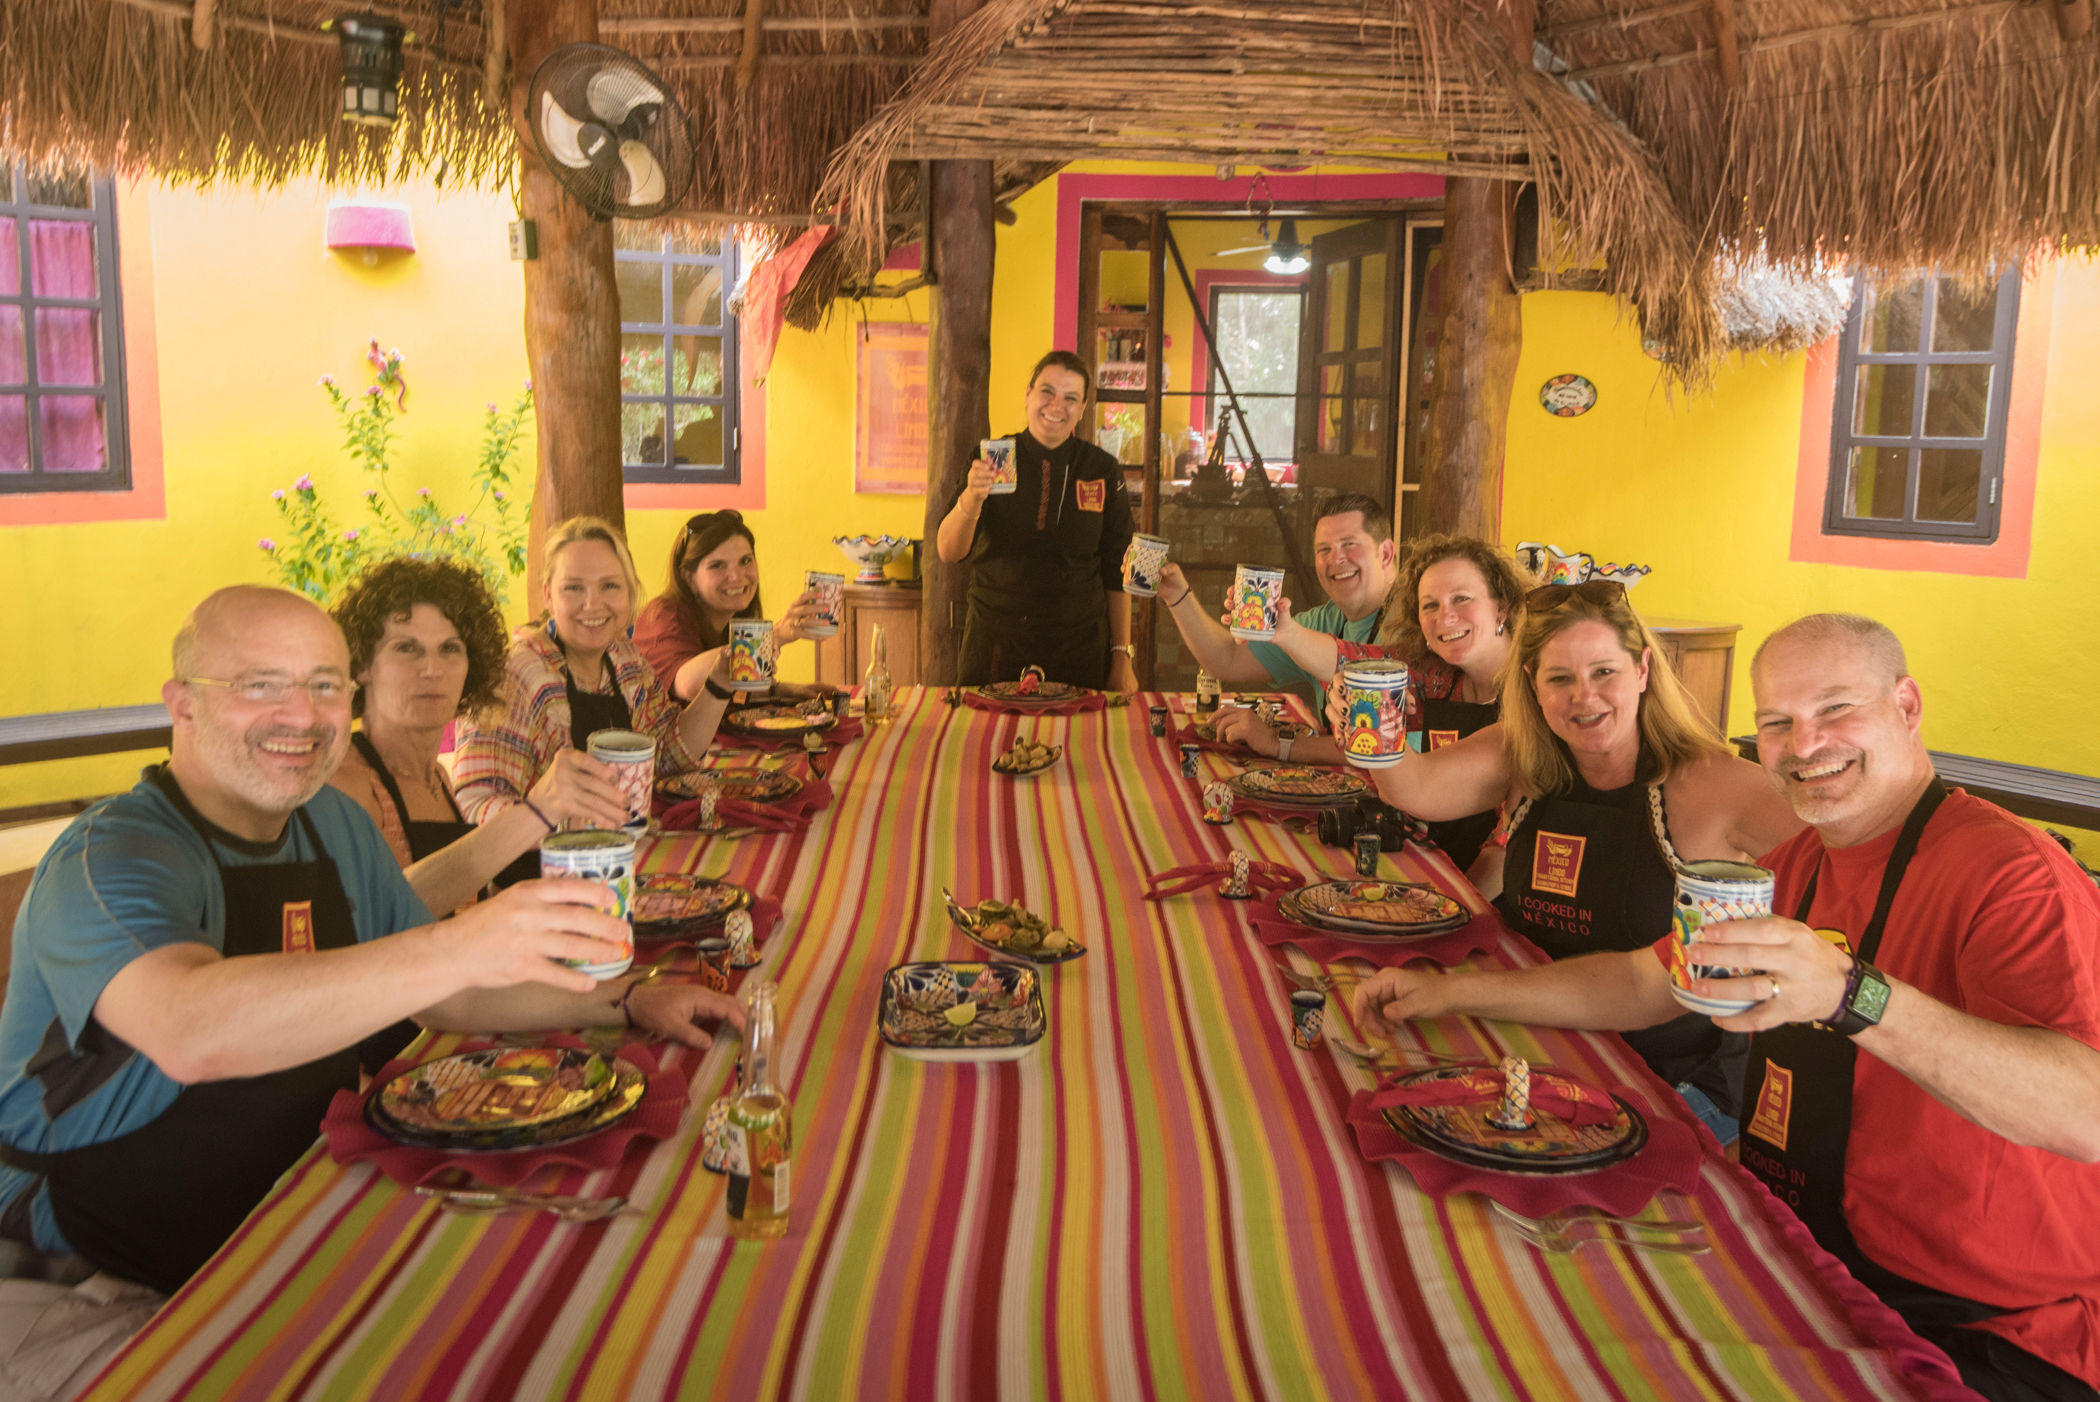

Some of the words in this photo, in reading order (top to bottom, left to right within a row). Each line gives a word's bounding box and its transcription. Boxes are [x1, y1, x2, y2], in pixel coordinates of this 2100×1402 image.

[1517, 894, 1522, 906] I
[1524, 896, 1577, 919] COOKED
[1579, 908, 1592, 922] IN
[1790, 1167, 1806, 1188] IN
